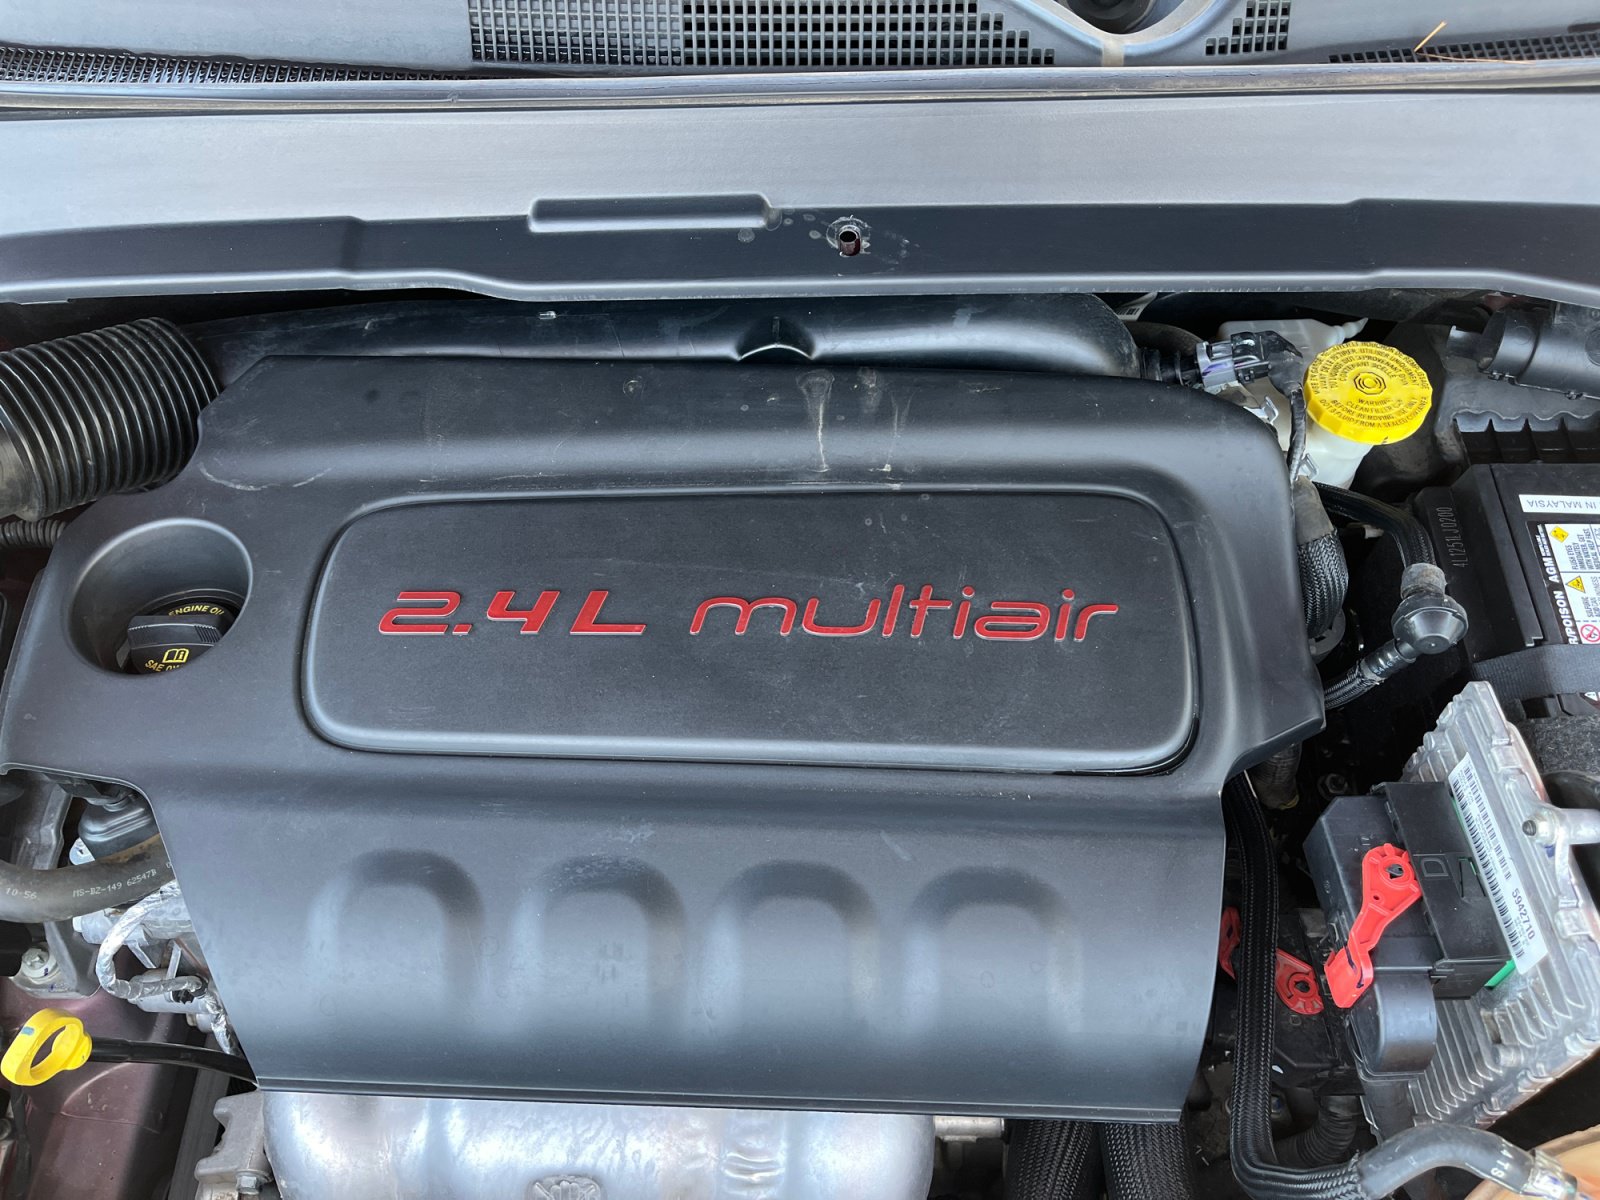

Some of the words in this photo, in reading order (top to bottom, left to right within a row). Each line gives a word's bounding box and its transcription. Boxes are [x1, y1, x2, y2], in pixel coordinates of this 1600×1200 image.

[1526, 499, 1583, 509] MALAYSIA
[1585, 501, 1597, 510] IN
[689, 584, 1119, 643] multiair
[145, 660, 165, 672] SAE
[1511, 888, 1536, 940] 5942710
